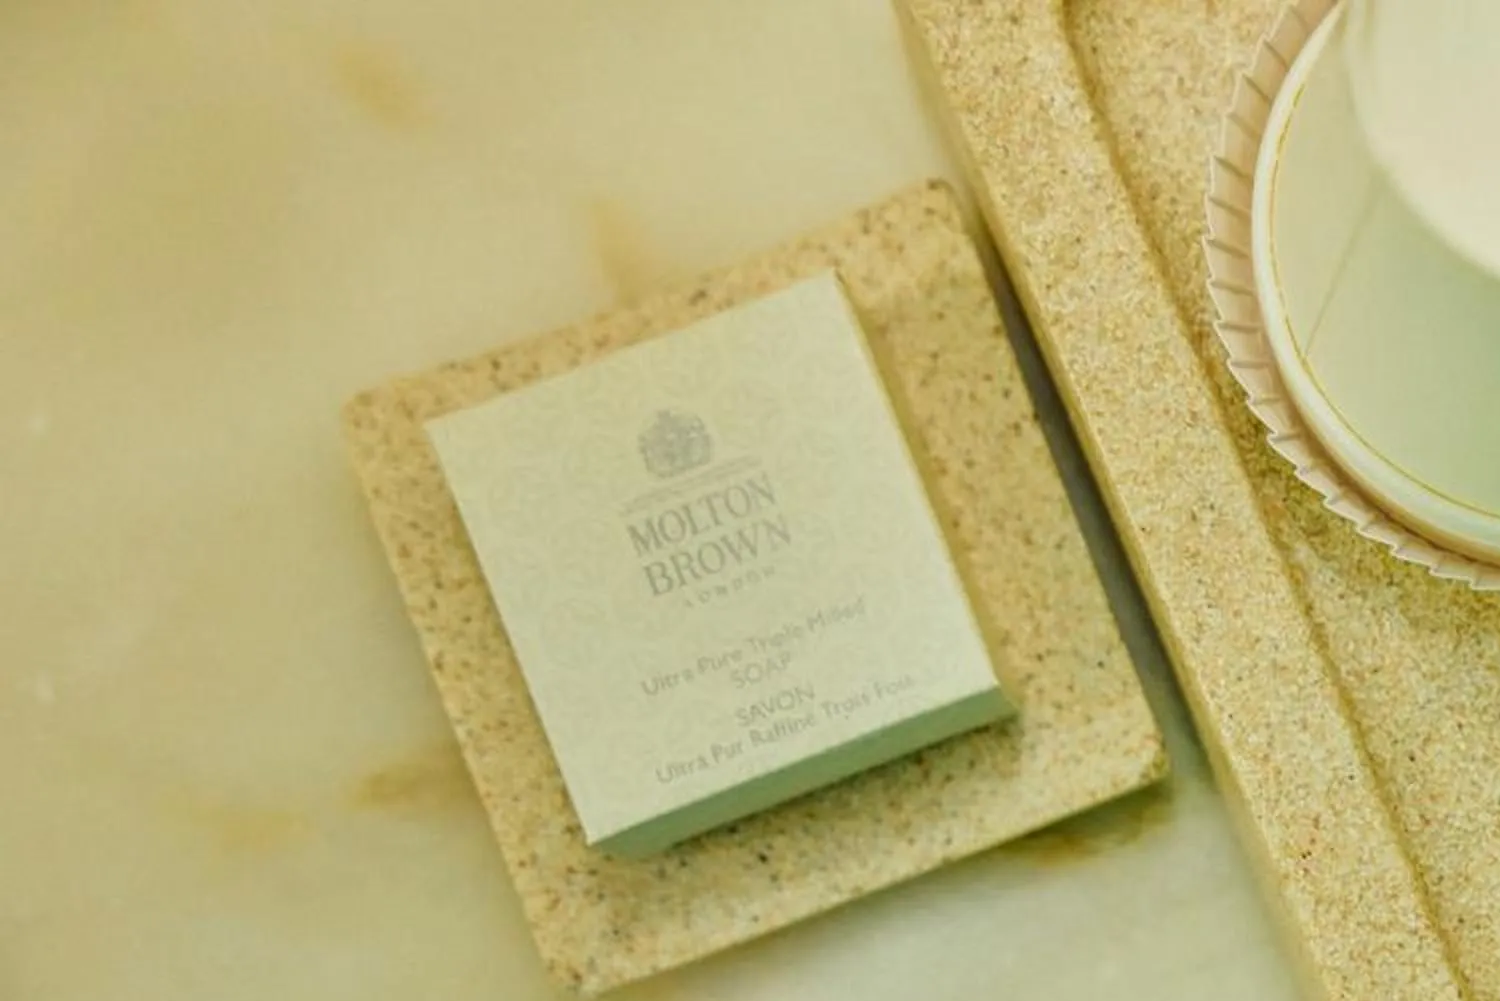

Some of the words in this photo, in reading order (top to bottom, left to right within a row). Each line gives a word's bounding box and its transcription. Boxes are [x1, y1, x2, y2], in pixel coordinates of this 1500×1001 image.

[626, 472, 776, 558] MOLTON
[643, 514, 792, 597] BROWN
[698, 647, 744, 677] Pure
[730, 653, 792, 689] SOAP
[734, 684, 816, 728] SAVON
